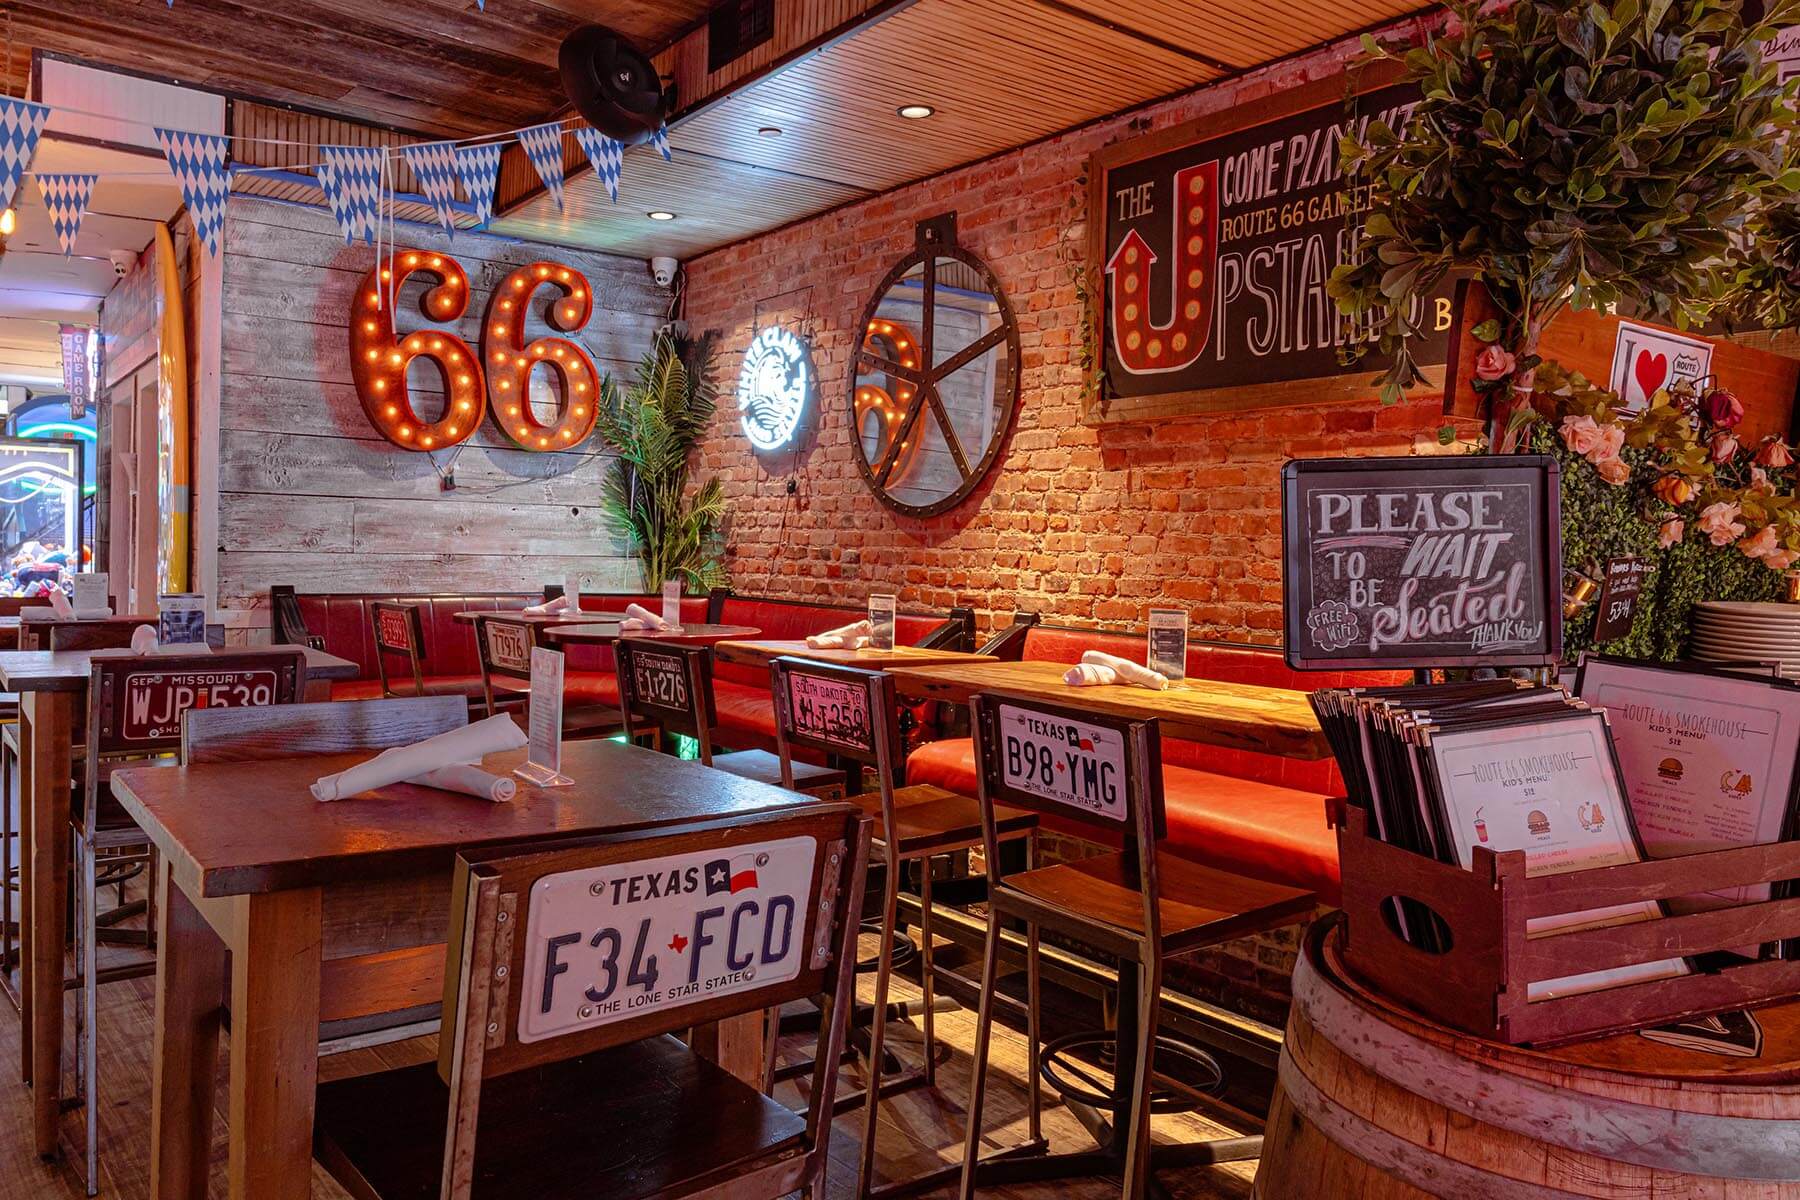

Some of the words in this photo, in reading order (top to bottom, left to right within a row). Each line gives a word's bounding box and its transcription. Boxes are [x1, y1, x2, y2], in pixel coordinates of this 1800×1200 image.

[1222, 140, 1284, 209] COME
[1116, 181, 1155, 222] THE
[1221, 207, 1277, 243] ROUTE
[1280, 200, 1305, 229] 66
[73, 334, 84, 373] GAME
[350, 250, 600, 452] 66
[1620, 339, 1636, 401] I
[1676, 360, 1697, 373] ROUTE
[73, 376, 85, 416] ROOM
[1315, 490, 1504, 534] PLEASE
[1325, 551, 1366, 580] TO
[1400, 532, 1514, 580] WAIT
[1350, 578, 1385, 608] BE
[1369, 561, 1527, 651] Seated
[1314, 610, 1343, 625] FREE
[1465, 619, 1515, 649] THANK
[132, 677, 154, 686] SEP
[171, 674, 238, 685] MISSOURI
[796, 680, 818, 696] SOUTH
[820, 686, 848, 702] DAKOTA
[132, 686, 194, 726] WJP
[1622, 703, 1656, 725] ROUTE
[1658, 709, 1670, 725] 66
[1675, 711, 1748, 740] SMOKEHOUSE
[159, 726, 181, 734] SHO
[1027, 717, 1065, 742] TEXAS
[1648, 724, 1673, 735] KID'S
[1675, 728, 1707, 741] MENU!
[1007, 735, 1054, 787] B98
[1065, 751, 1117, 805] YMG
[1472, 760, 1502, 784] ROUTE
[1502, 759, 1519, 780] 66
[1519, 751, 1579, 777] SMOKEHOUSE
[1502, 777, 1524, 788] KID'S
[610, 866, 699, 906] TEXAS
[541, 918, 660, 1014] F34
[688, 894, 796, 983] FCD
[596, 998, 621, 1015] THE
[627, 992, 662, 1009] LONE
[668, 983, 700, 1001] STAR
[705, 971, 742, 993] STATE
